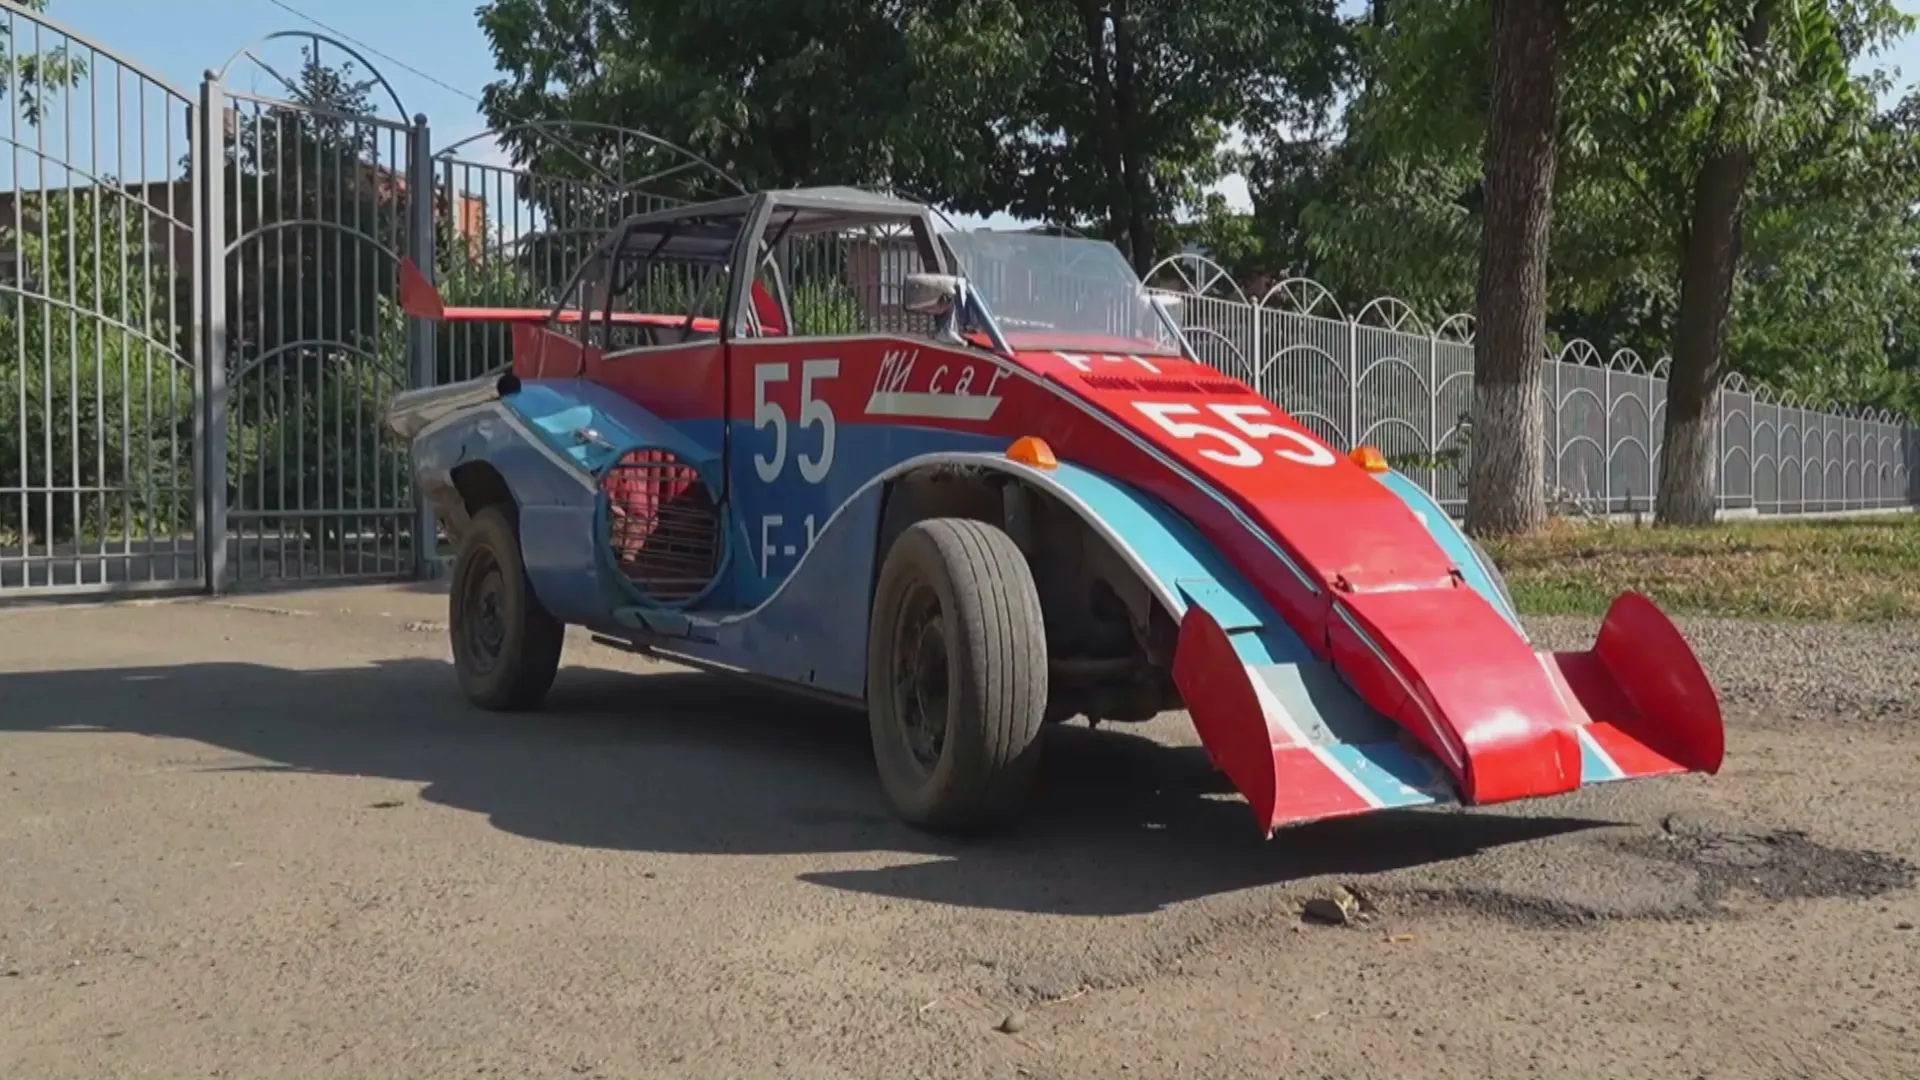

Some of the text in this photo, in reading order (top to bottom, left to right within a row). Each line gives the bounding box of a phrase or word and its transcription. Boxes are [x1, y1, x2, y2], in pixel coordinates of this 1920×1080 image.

[754, 358, 840, 484] 55
[1131, 401, 1336, 468] 55
[761, 513, 816, 580] F-1
